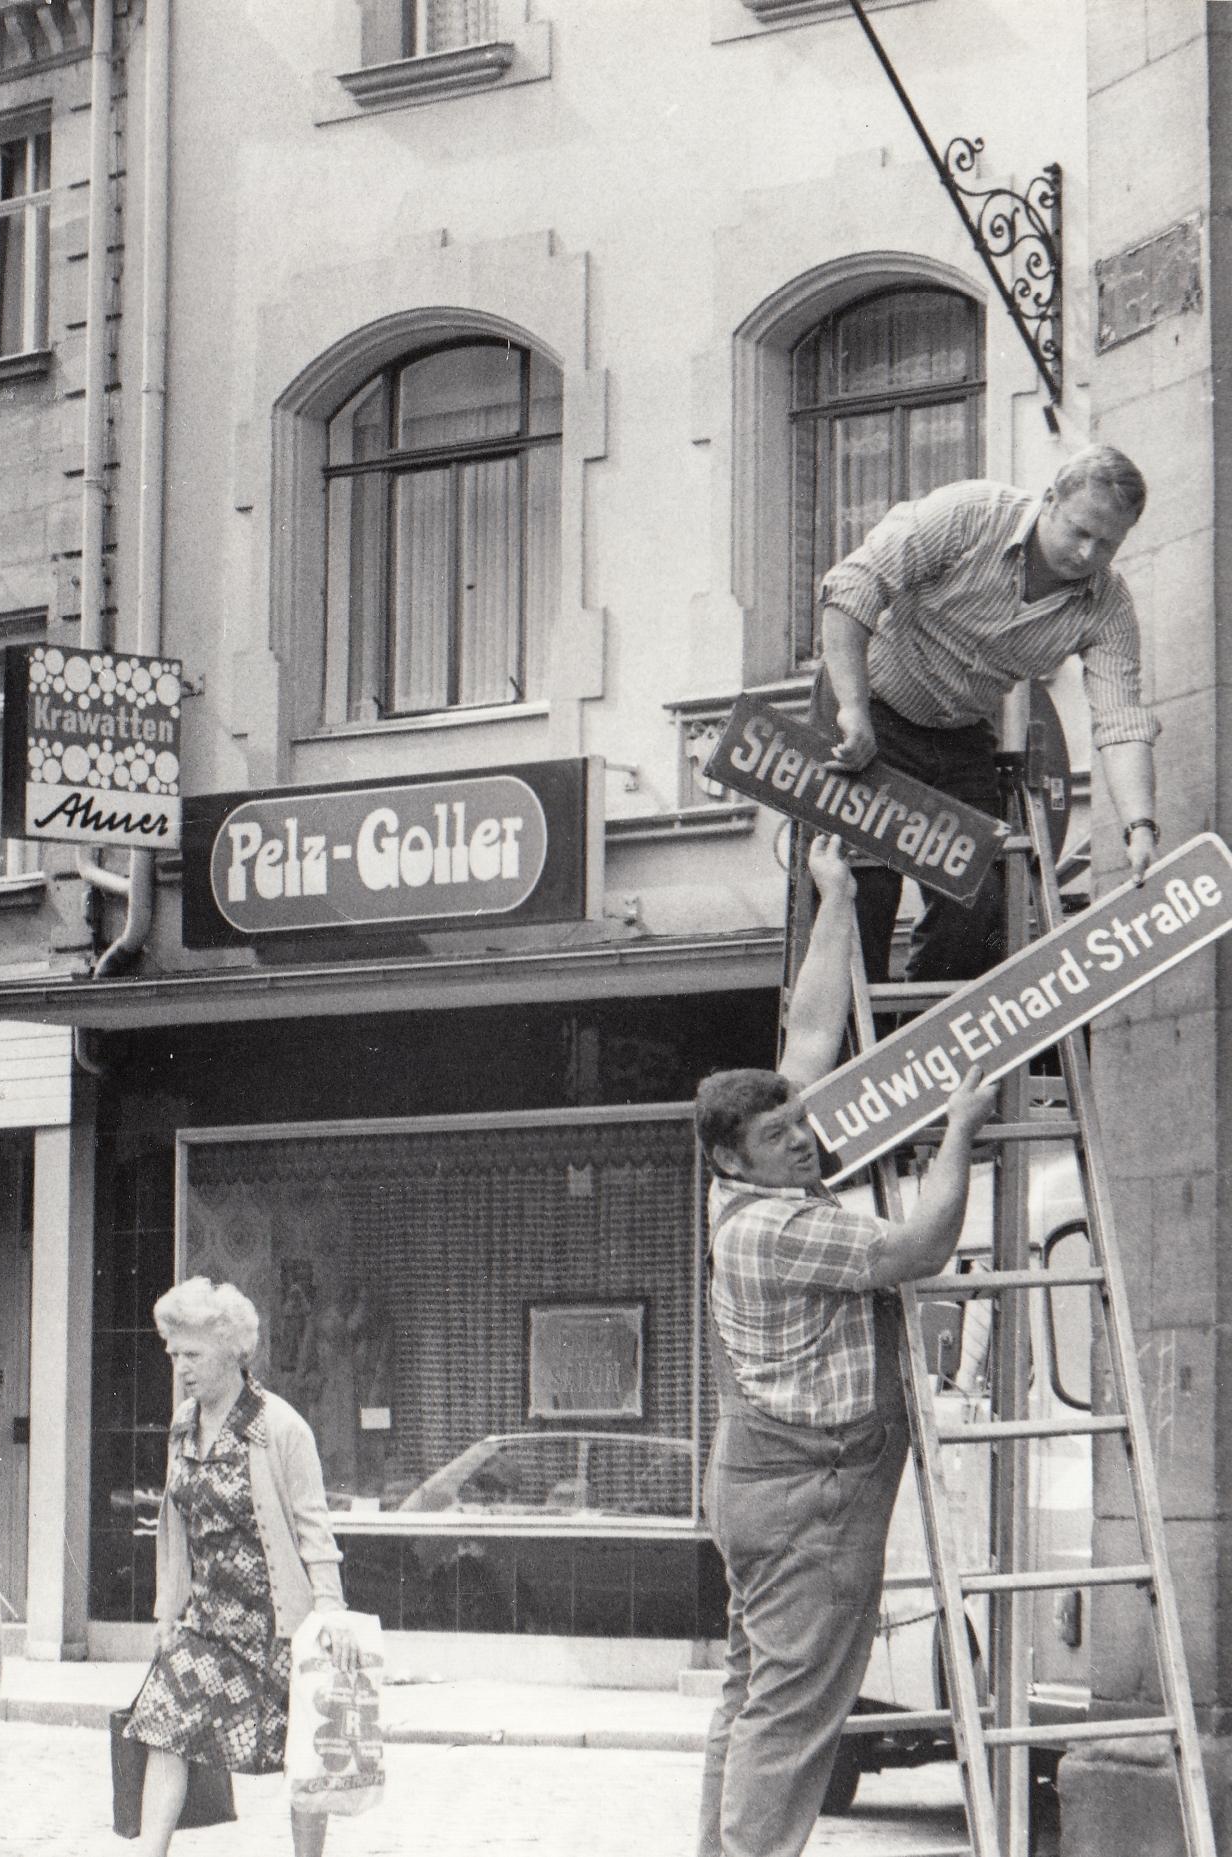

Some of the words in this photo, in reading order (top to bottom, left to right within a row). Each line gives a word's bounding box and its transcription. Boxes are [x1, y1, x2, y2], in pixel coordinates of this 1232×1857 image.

[33, 701, 174, 742] Krawatten
[228, 801, 523, 902] Pelz-Goller
[729, 714, 976, 877] Sternstraße
[808, 872, 1223, 1153] Ludwig-Erhard-Straße
